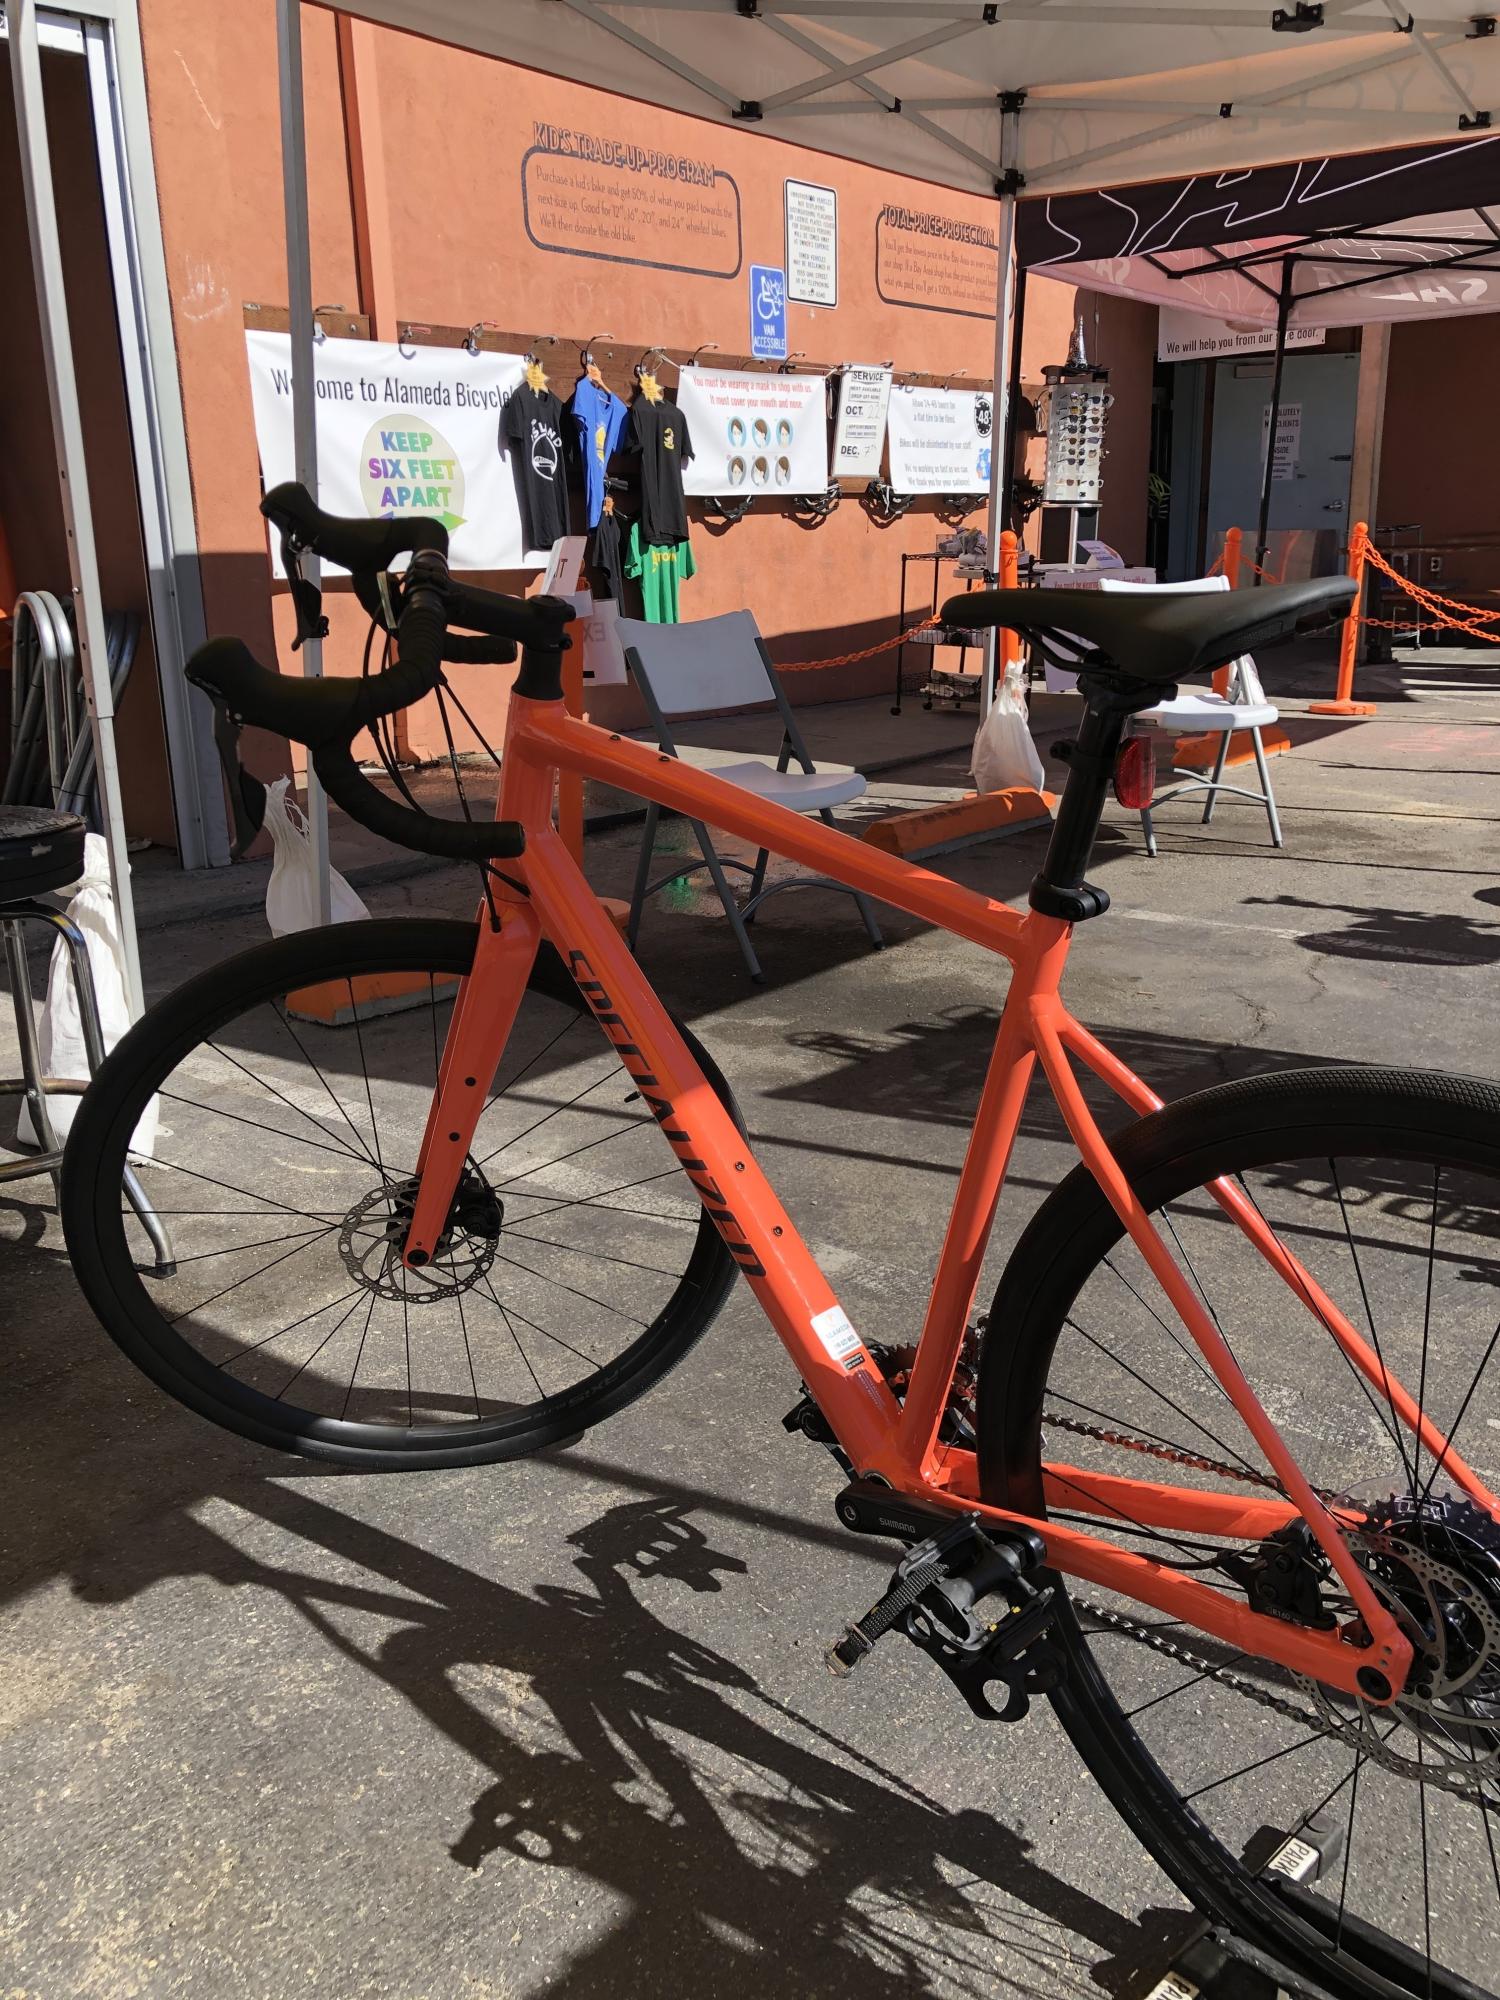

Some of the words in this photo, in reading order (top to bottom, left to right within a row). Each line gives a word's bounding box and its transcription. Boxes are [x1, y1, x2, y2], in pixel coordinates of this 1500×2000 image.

[533, 121, 573, 154] KID'S
[648, 149, 715, 187] PROGRAM
[536, 165, 568, 186] Purchase
[592, 176, 605, 193] bike
[608, 181, 619, 197] and
[621, 188, 630, 202] get
[632, 188, 648, 202] 50%
[650, 188, 656, 203] of
[658, 192, 672, 207] what
[674, 200, 685, 212] you
[686, 200, 699, 214] paid
[701, 201, 723, 217] towards
[724, 205, 733, 219] the
[582, 197, 600, 215] Good
[601, 200, 611, 216] for
[659, 216, 670, 228] and
[686, 219, 710, 235] wheeled
[883, 204, 912, 231] TOTAL
[914, 211, 940, 236] PRICE
[942, 217, 995, 247] PROTECTION
[558, 216, 572, 232] then
[574, 220, 597, 236] donate
[598, 224, 609, 238] the
[610, 225, 620, 240] old
[764, 324, 776, 336] VAN
[754, 336, 785, 350] ACCESSIBLE
[1166, 342, 1180, 354] We
[1182, 340, 1197, 352] will
[1200, 338, 1216, 352] help
[1218, 337, 1234, 350] you
[1236, 334, 1256, 346] from
[1258, 333, 1274, 344] our
[693, 376, 704, 387] You
[704, 377, 718, 388] must
[720, 378, 727, 389] be
[728, 379, 750, 392] wearing
[756, 380, 770, 392] mask
[770, 382, 777, 392] to
[778, 382, 790, 393] shop
[792, 382, 804, 393] with
[853, 371, 884, 380] SERVICE
[271, 368, 354, 401] Wome
[360, 378, 377, 402] to
[384, 377, 452, 406] Alameda
[710, 394, 714, 405] It
[716, 395, 730, 406] must
[731, 398, 746, 407] cover
[747, 398, 758, 409] your
[760, 397, 777, 408] mouth
[778, 398, 788, 408] and
[846, 405, 864, 415] OCT.
[978, 410, 989, 424] 48
[380, 431, 433, 453] KEEP
[841, 446, 860, 456] DEC.
[368, 458, 406, 479] SIX
[408, 460, 455, 480] FEET
[381, 486, 452, 508] APART
[568, 950, 766, 1276] SPECIALIZED
[879, 1517, 916, 1534] SHIMANO
[1274, 1842, 1310, 1876] PARK
